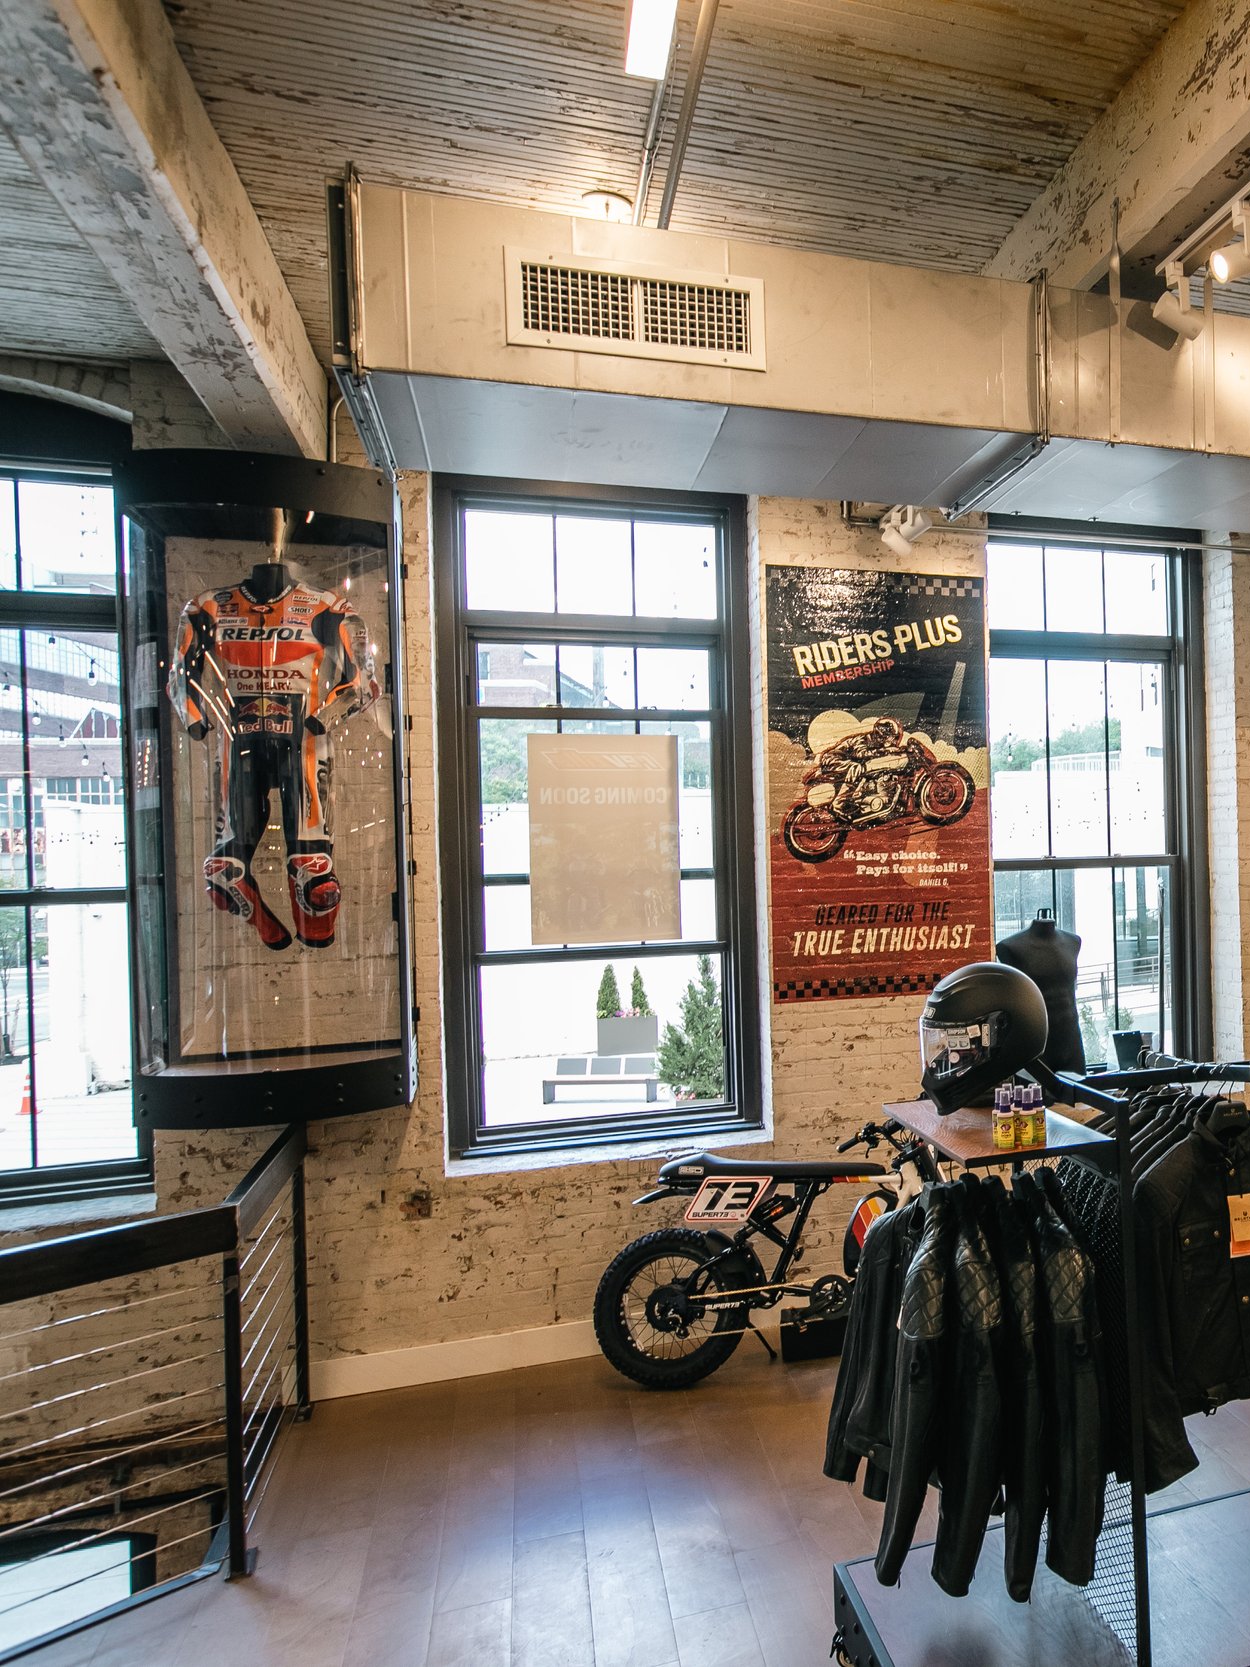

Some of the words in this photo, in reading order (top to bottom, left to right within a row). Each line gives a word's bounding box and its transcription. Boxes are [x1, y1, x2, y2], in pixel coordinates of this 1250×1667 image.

[222, 627, 305, 641] REPSOL
[792, 629, 892, 676] RIDERS
[893, 614, 963, 654] PLUS
[227, 669, 306, 679] HONDA
[801, 659, 895, 690] MEMBERSHIP
[236, 682, 253, 691] One
[238, 717, 263, 735] Red
[264, 718, 294, 735] Bull
[891, 850, 941, 860] choice.
[856, 864, 890, 877] Pays
[893, 864, 914, 874] for
[919, 878, 942, 887] DANIEL
[815, 904, 879, 927] GEARED
[884, 902, 915, 924] FOR
[922, 901, 951, 922] THE
[793, 929, 848, 957] TRUE
[852, 924, 976, 954] ENTHUSIAST
[705, 1181, 760, 1211] 73
